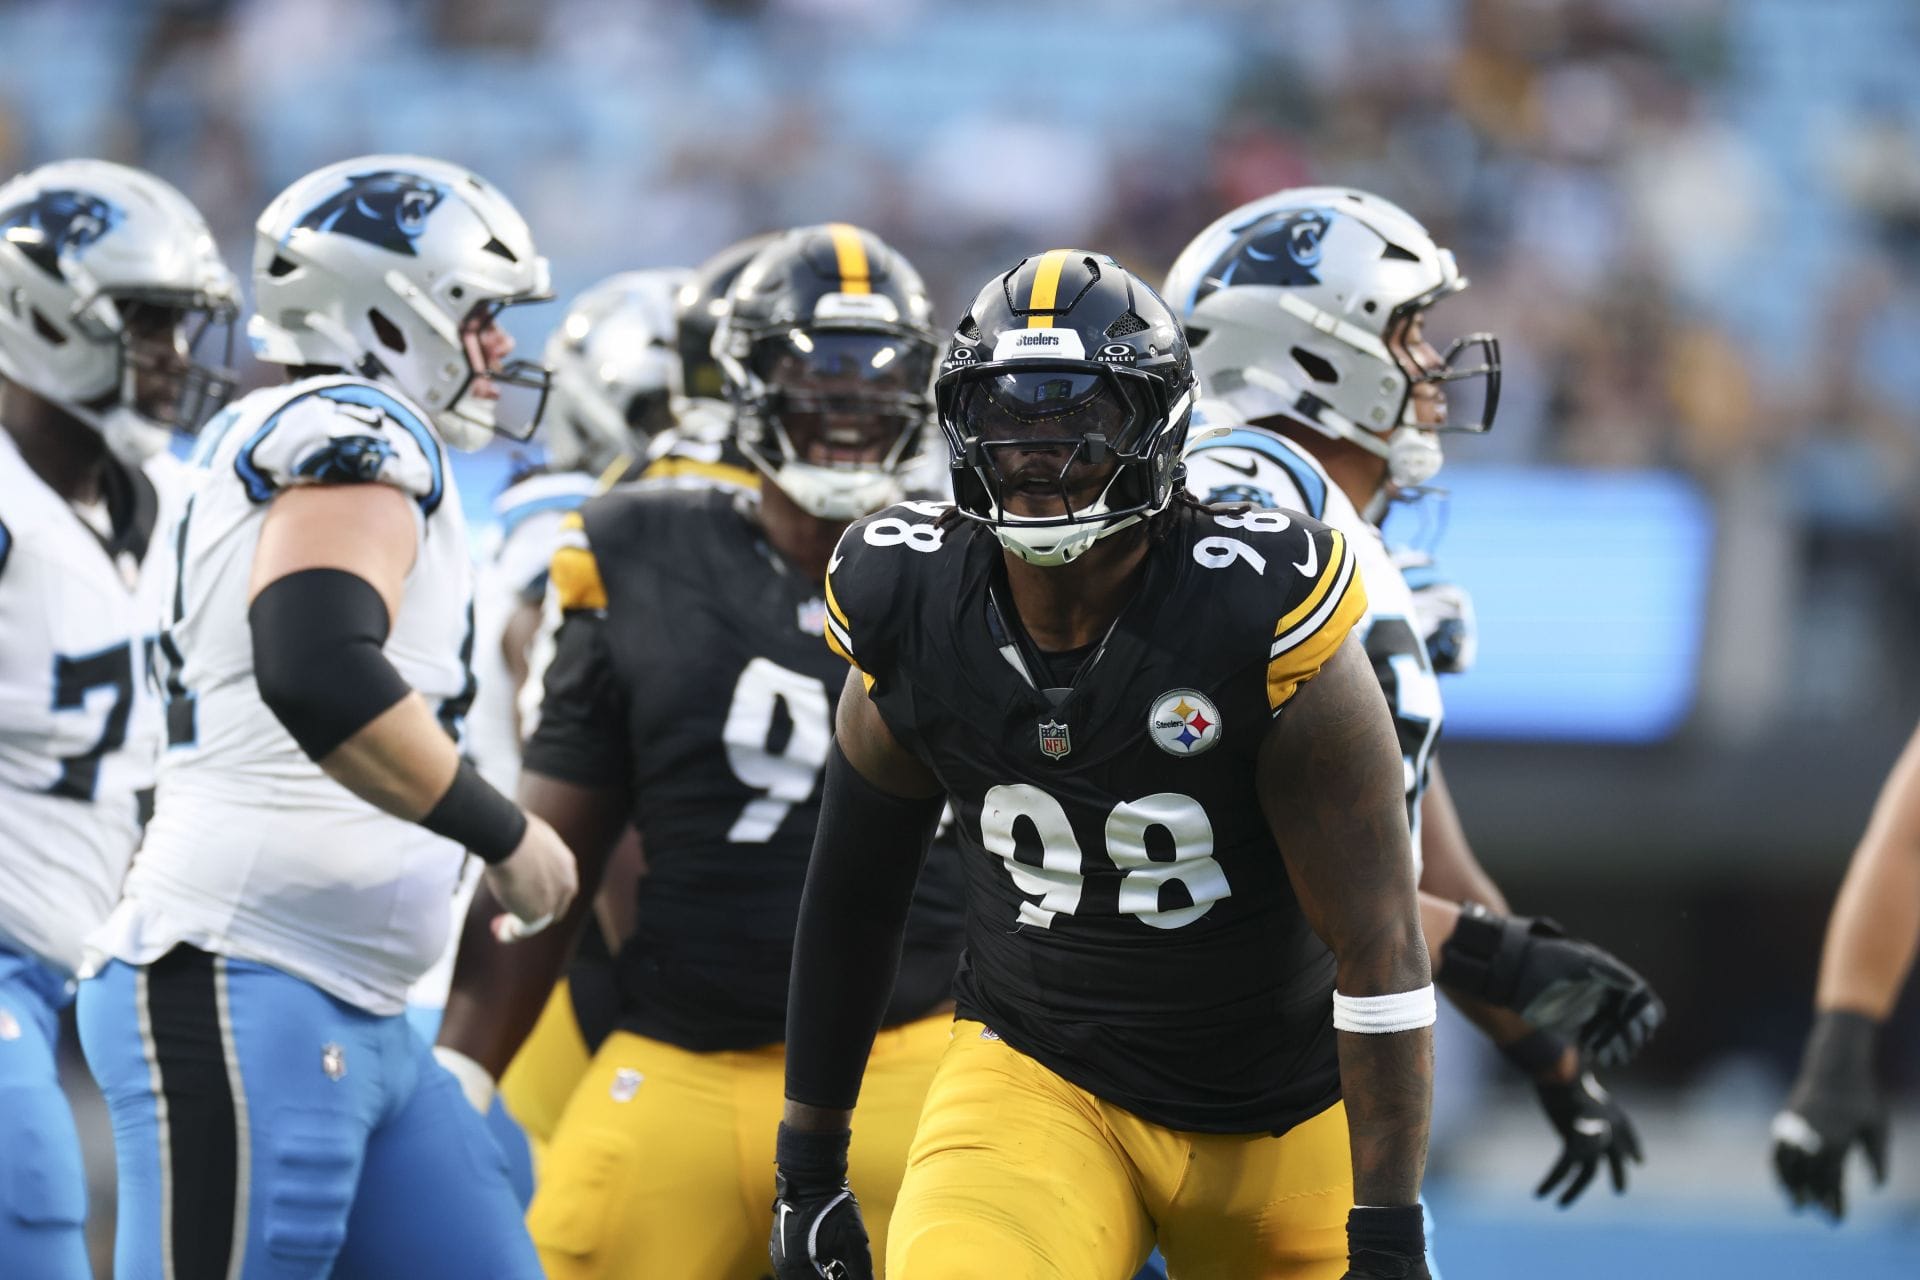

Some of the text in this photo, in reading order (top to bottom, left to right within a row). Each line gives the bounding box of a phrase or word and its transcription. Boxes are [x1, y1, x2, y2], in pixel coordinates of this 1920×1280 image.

[1016, 332, 1060, 347] Steelers
[1192, 511, 1291, 576] 98
[1156, 720, 1184, 729] Steelers
[1045, 739, 1068, 753] NFL
[980, 783, 1232, 930] 98
